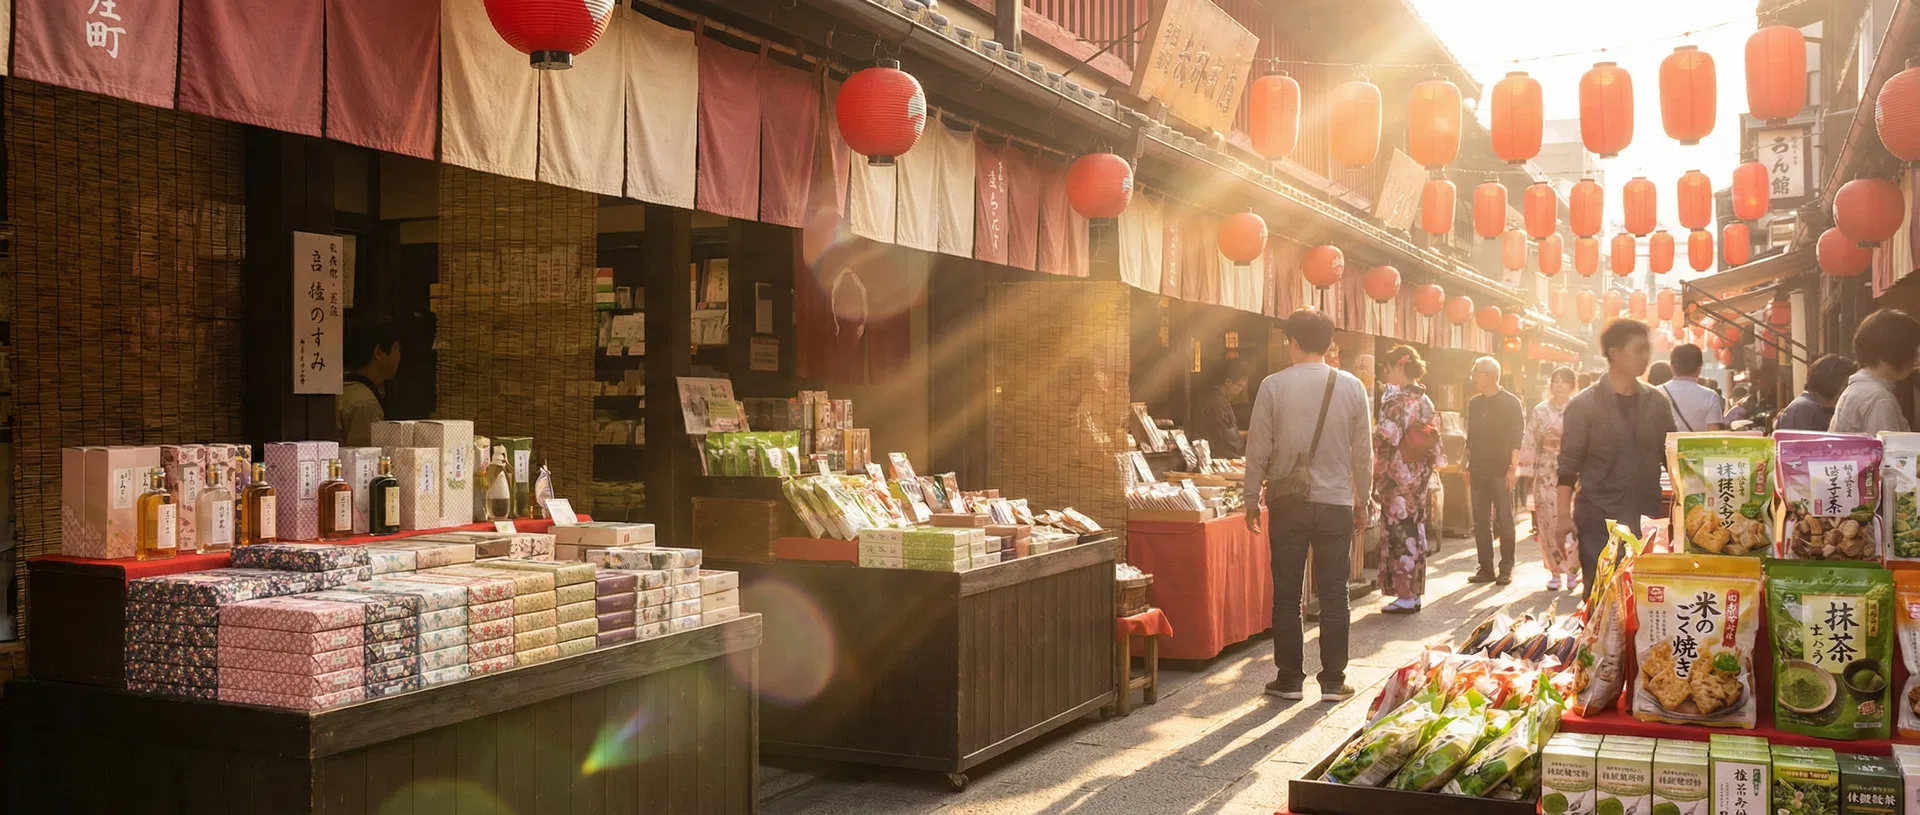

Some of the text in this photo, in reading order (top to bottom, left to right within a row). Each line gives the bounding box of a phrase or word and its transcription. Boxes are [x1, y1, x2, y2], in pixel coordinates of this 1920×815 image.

[1672, 603, 1698, 678] ごく焼き
[1692, 591, 1722, 635] 米の
[1824, 601, 1860, 663] 抹茶
